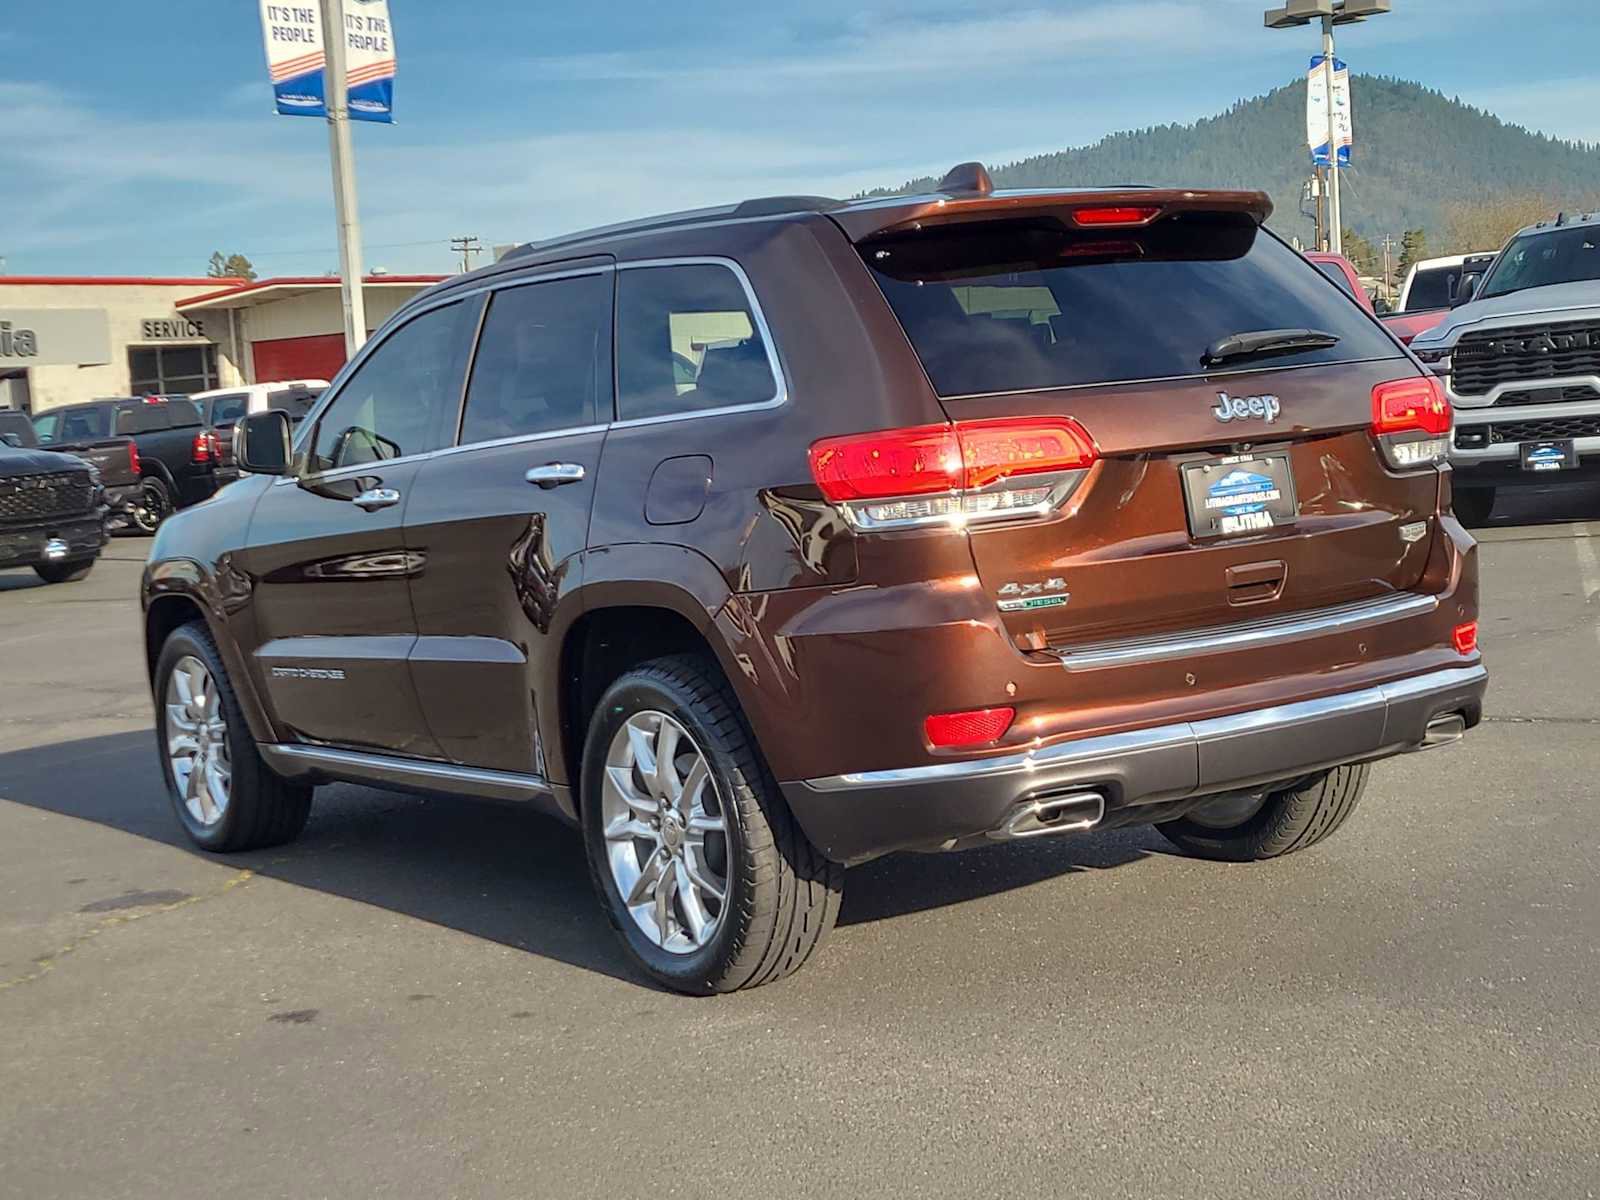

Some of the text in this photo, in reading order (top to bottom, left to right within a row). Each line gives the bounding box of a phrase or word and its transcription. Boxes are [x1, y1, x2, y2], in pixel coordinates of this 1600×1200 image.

[267, 5, 315, 24] IT'S THE
[345, 14, 387, 33] IT'S THE
[272, 26, 315, 43] PEOPLE
[348, 34, 388, 52] PEOPLE
[143, 321, 205, 338] SERVICE
[1212, 391, 1280, 423] Jeep
